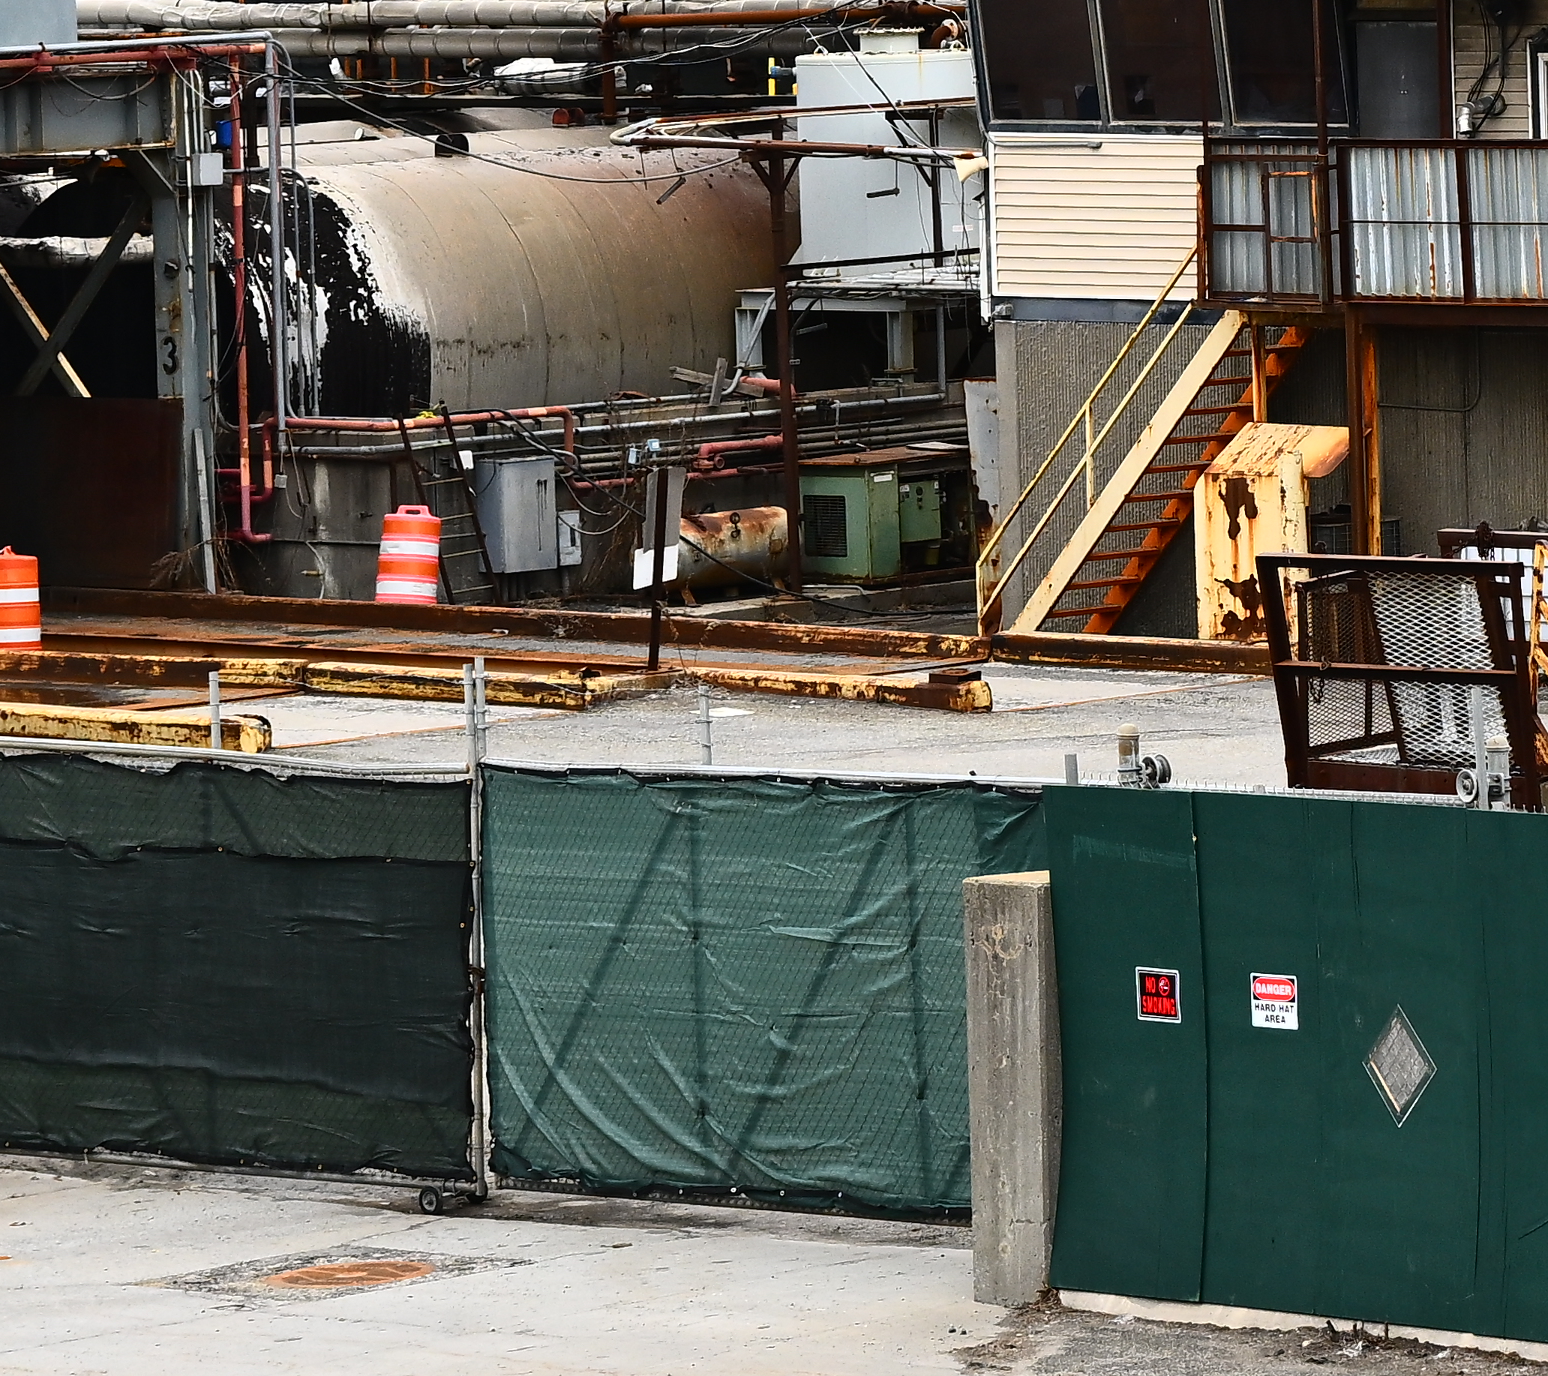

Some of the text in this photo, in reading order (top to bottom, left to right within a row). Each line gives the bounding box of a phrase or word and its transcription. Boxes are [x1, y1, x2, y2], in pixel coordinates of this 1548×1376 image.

[161, 336, 179, 376] 3
[1145, 975, 1156, 994] NO
[1255, 983, 1293, 996] DANGER
[1142, 995, 1177, 1016] SMOKING
[1254, 1002, 1294, 1014] HARD HAT
[1264, 1014, 1286, 1024] AREA
